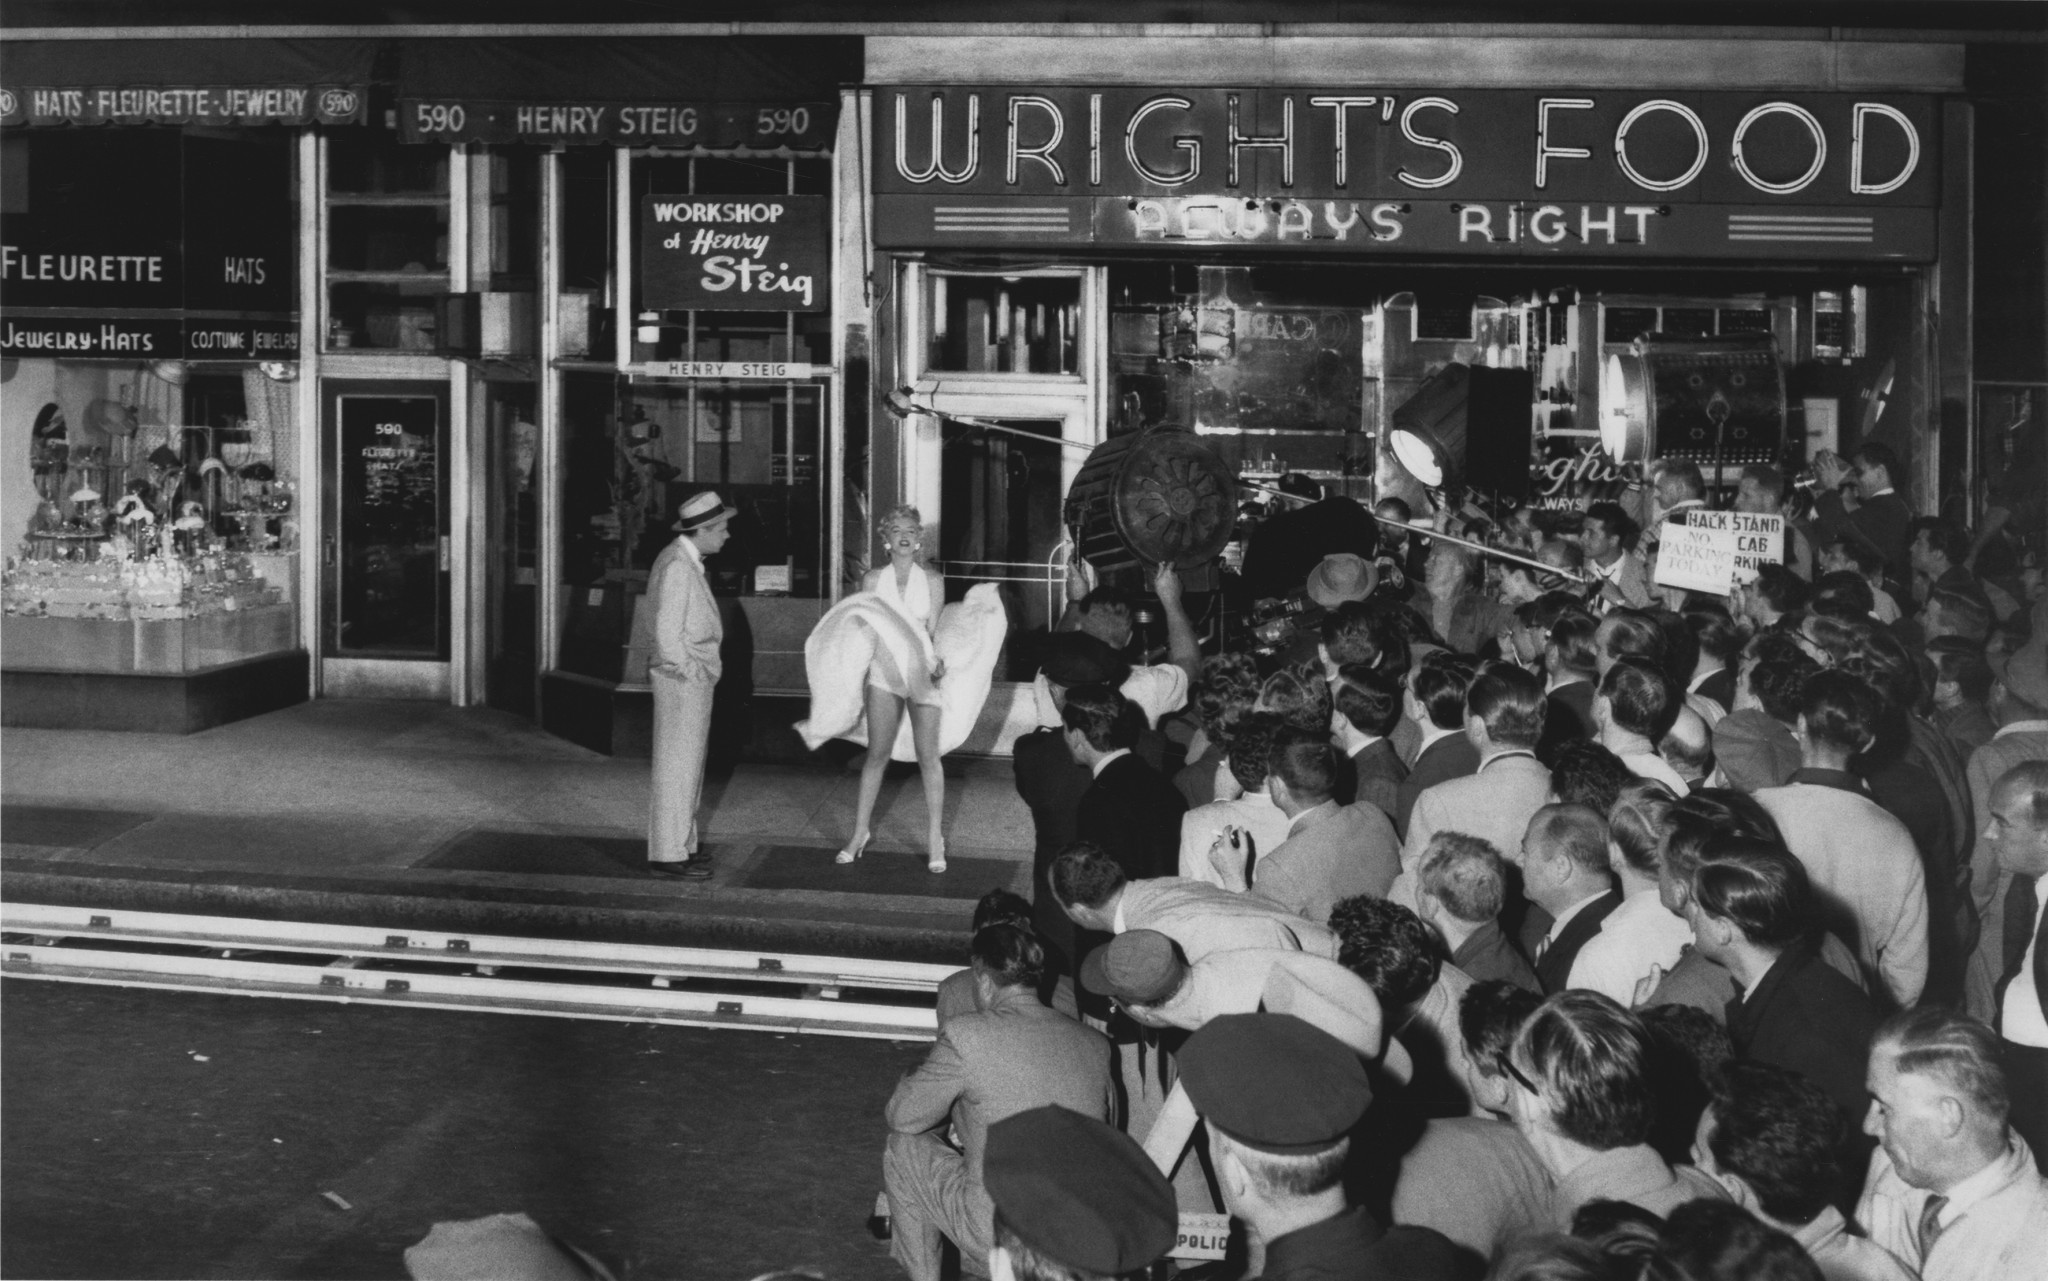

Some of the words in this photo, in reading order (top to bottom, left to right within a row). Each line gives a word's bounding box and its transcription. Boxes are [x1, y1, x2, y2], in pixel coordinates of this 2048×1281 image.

[34, 90, 82, 116] HATS
[98, 90, 210, 116] FLEURETTE
[220, 90, 308, 116] JEWELRY
[326, 94, 354, 112] 590
[418, 104, 465, 132] 590
[517, 107, 604, 134] HENRY
[619, 107, 698, 134] STEIG
[757, 107, 809, 134] 590
[895, 93, 1463, 188] WRIGHT'S
[1535, 98, 1920, 195] FOOD
[654, 203, 784, 222] WORKSHOP
[1458, 204, 1658, 245] RIGHT
[689, 228, 769, 258] Henry
[1, 246, 162, 282] FLEURETTE
[225, 257, 265, 285] HATS
[701, 254, 813, 306] Steig
[191, 331, 245, 349] COSTUME
[248, 329, 298, 357] JEWELRY
[669, 363, 724, 376] HENRY
[741, 364, 787, 377] STEIG
[375, 423, 402, 435] 590
[1732, 513, 1780, 533] STAND
[1688, 531, 1711, 546] NO
[1737, 536, 1769, 553] CAB
[1666, 556, 1723, 577] TODAY
[1177, 1234, 1227, 1250] POLIC
